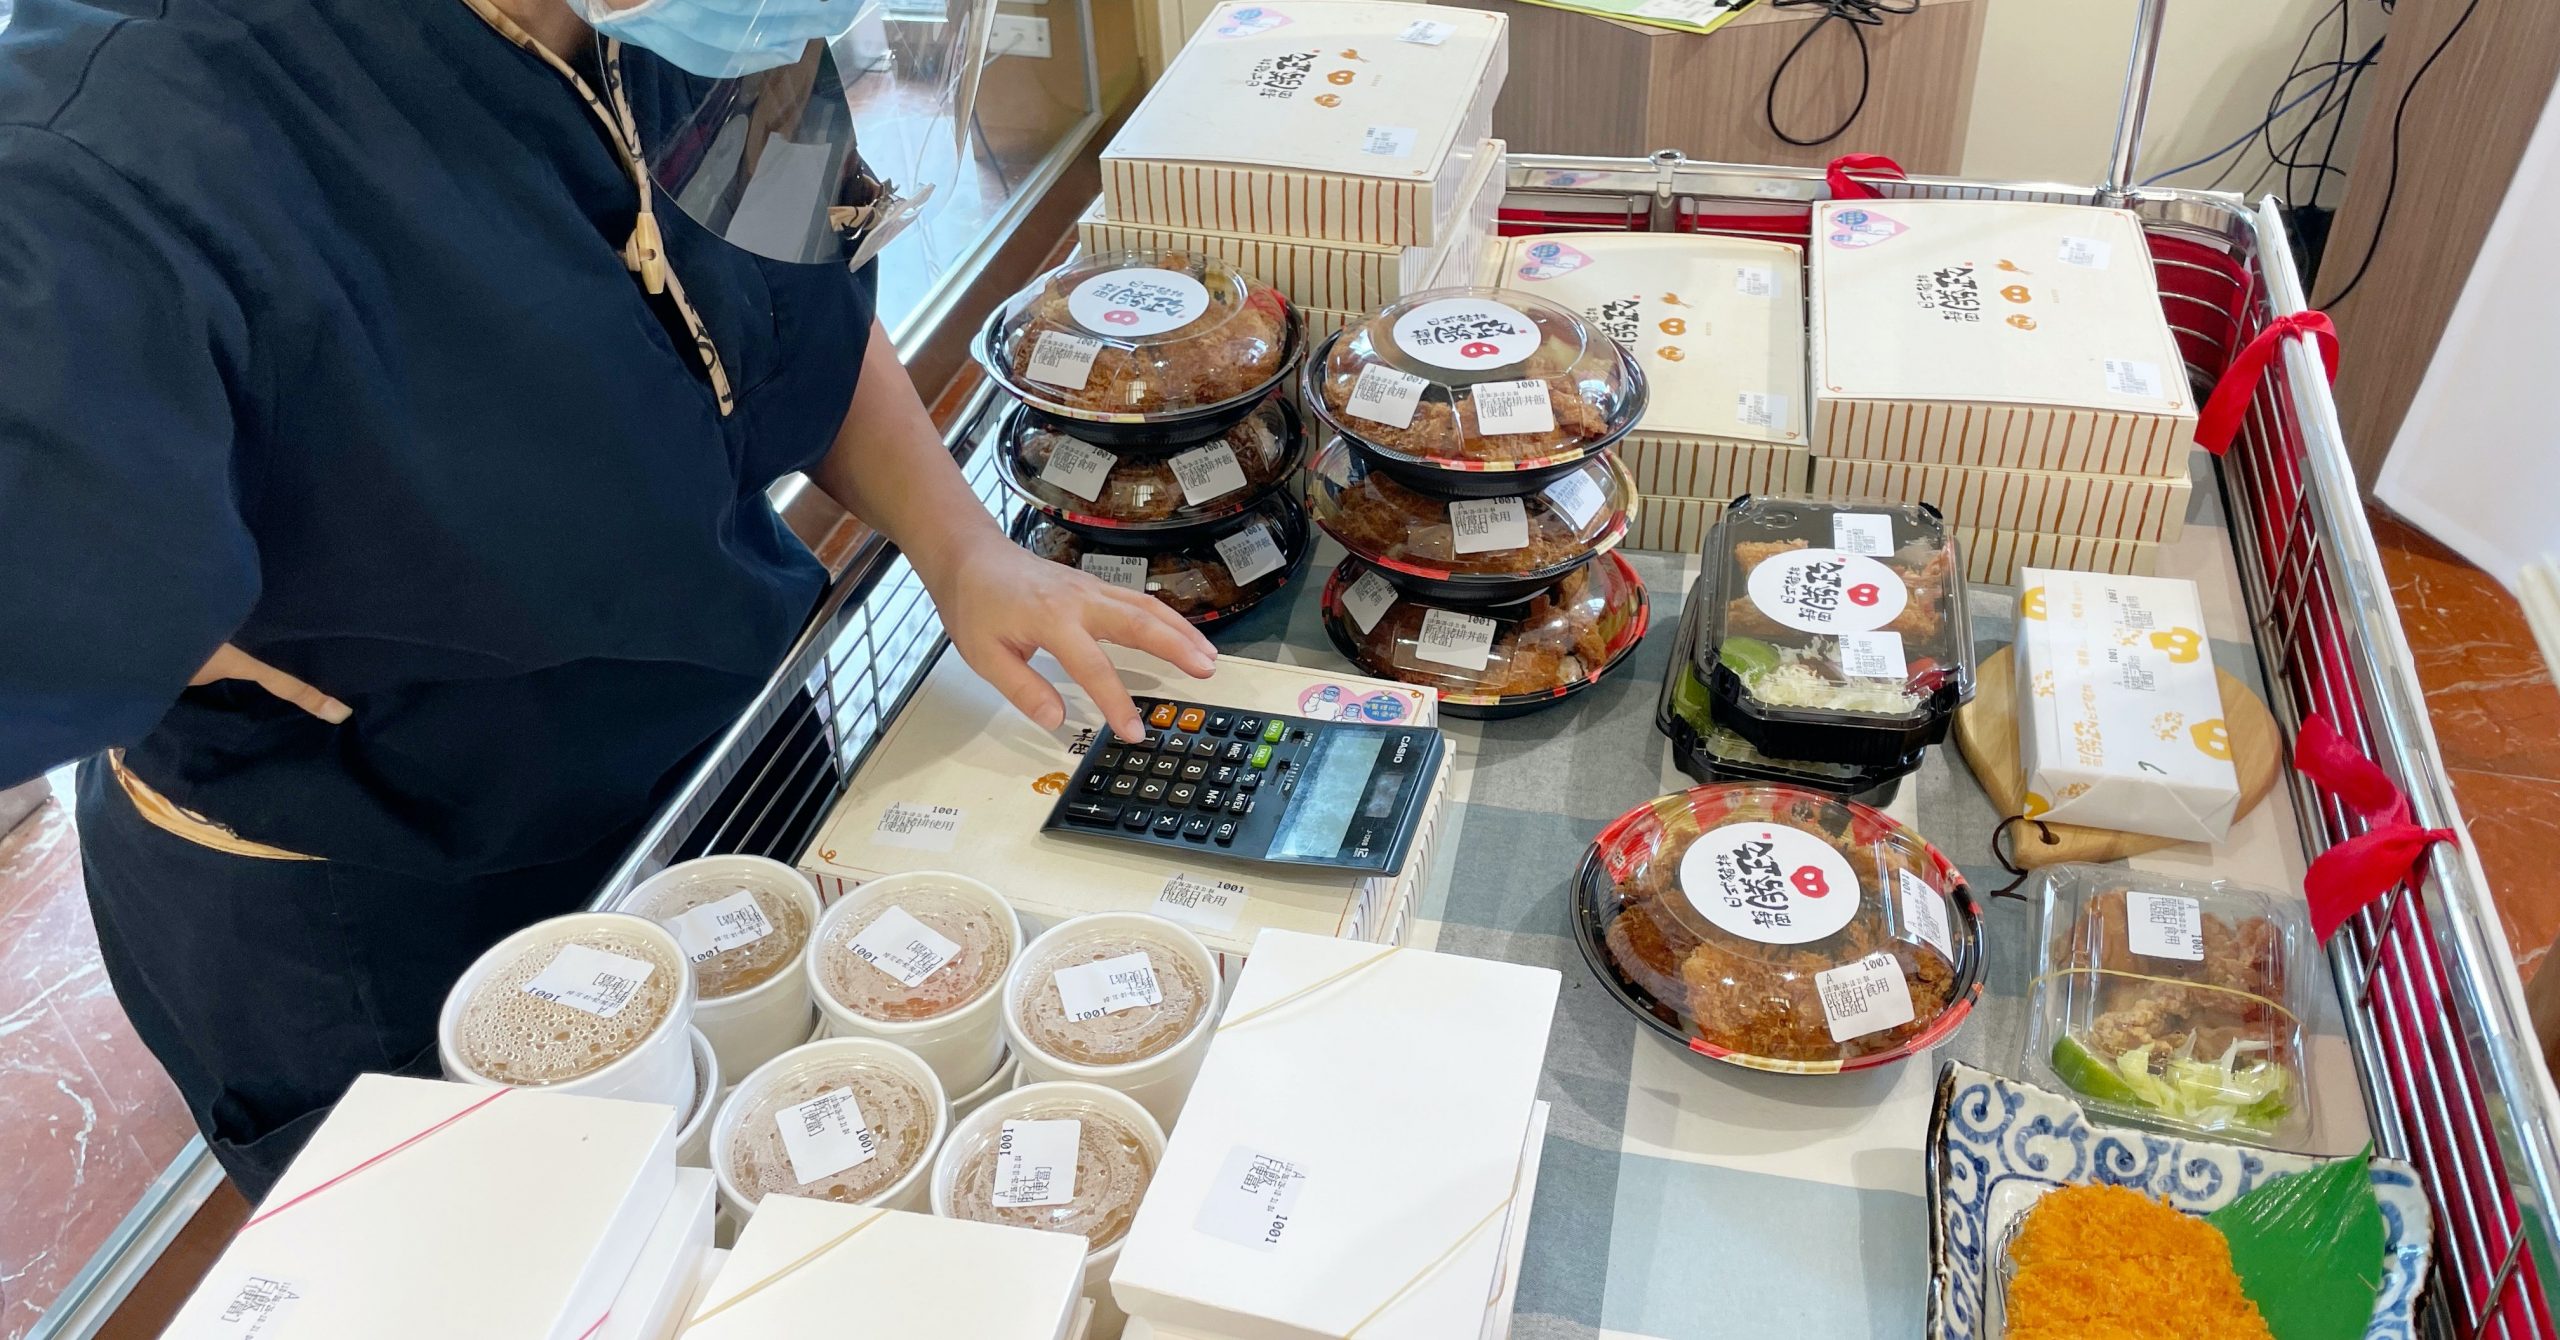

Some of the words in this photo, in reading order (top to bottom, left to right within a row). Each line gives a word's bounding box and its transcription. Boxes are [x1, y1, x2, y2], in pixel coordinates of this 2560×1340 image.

[1077, 337, 1098, 348] 1001
[1401, 373, 1423, 385] 1001
[1515, 381, 1540, 389] 1001
[1203, 439, 1223, 453] 1001
[1092, 447, 1112, 461] 1001
[1493, 496, 1517, 504] 1001
[1243, 525, 1261, 537] 1001
[1120, 557, 1142, 566] 1001
[1467, 616, 1491, 627] 1001
[2110, 648, 2118, 663] 1001
[1156, 707, 1169, 720] AC
[1184, 713, 1197, 721] C
[1170, 738, 1183, 746] 4
[1227, 743, 1242, 758] MRC
[1393, 736, 1411, 763] CASIO
[1129, 757, 1143, 765] 2
[1158, 761, 1172, 769] 5
[1187, 765, 1200, 773] 8
[1218, 766, 1231, 780] M-
[1116, 781, 1130, 789] 3
[1176, 789, 1189, 797] 9
[1205, 790, 1219, 804] M+
[932, 805, 959, 815] 1001
[1220, 823, 1231, 835] GT
[1715, 853, 1743, 908] 日式豬排
[1731, 841, 1789, 910] 勝政
[1217, 880, 1246, 894] 1001
[1902, 874, 1911, 896] 1001
[717, 904, 758, 925] [便當]
[907, 939, 943, 963] [便當]
[2192, 934, 2204, 955] 1001
[690, 945, 720, 964] 1001
[852, 943, 878, 963] 1001
[1863, 955, 1890, 971] 1001
[591, 971, 638, 994] [便當]
[1110, 967, 1149, 985] [便當]
[1826, 972, 1834, 984] A
[527, 988, 561, 1002] 1001
[1824, 977, 1890, 1009] 限當日食用
[1075, 1006, 1108, 1021] 1001
[799, 1106, 824, 1136] [便當]
[855, 1128, 875, 1154] 1001
[1000, 1128, 1013, 1156] 1001
[1262, 1158, 1285, 1187] 白飯
[1292, 1171, 1306, 1179] A
[1033, 1165, 1049, 1201] [便當]
[1265, 1214, 1288, 1243] 1001
